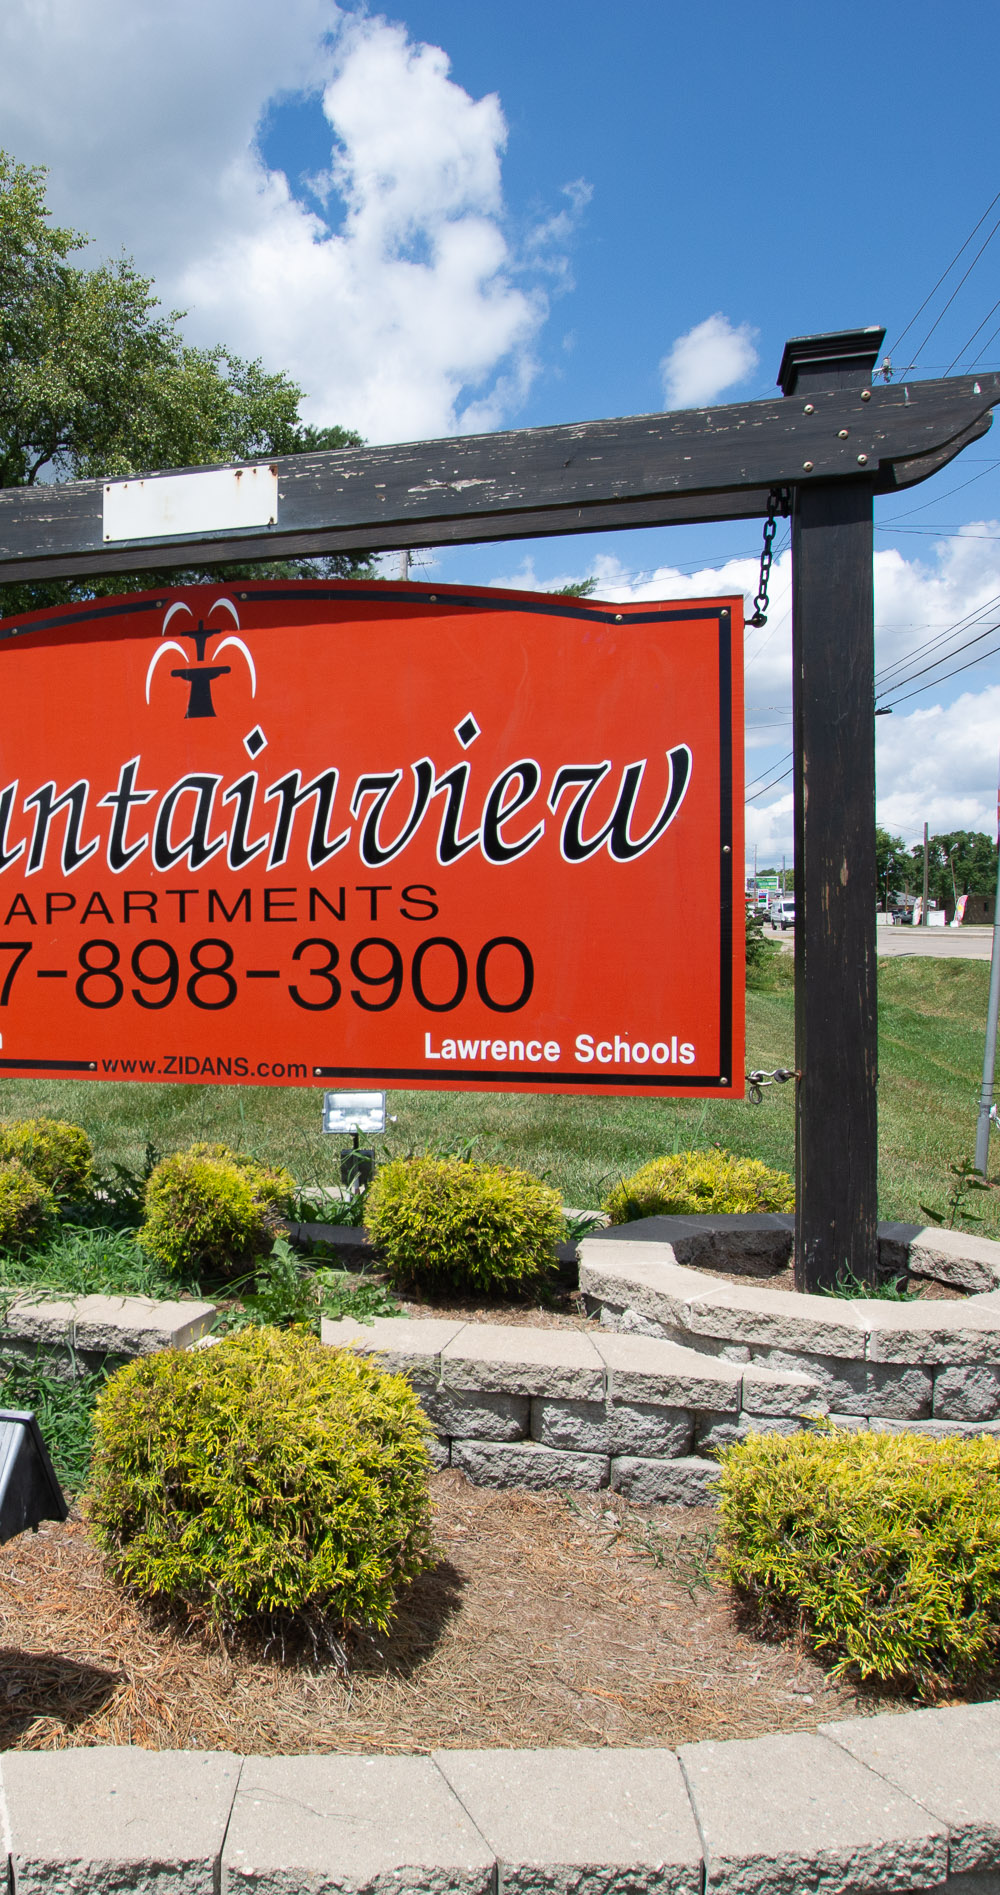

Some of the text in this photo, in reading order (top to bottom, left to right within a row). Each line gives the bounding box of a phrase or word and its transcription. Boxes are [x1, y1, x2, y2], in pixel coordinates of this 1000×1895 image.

[4, 884, 439, 926] APARTMENTS
[424, 1032, 696, 1065] Lawrence Schools
[101, 1055, 308, 1078] www.ZIDANS.com
